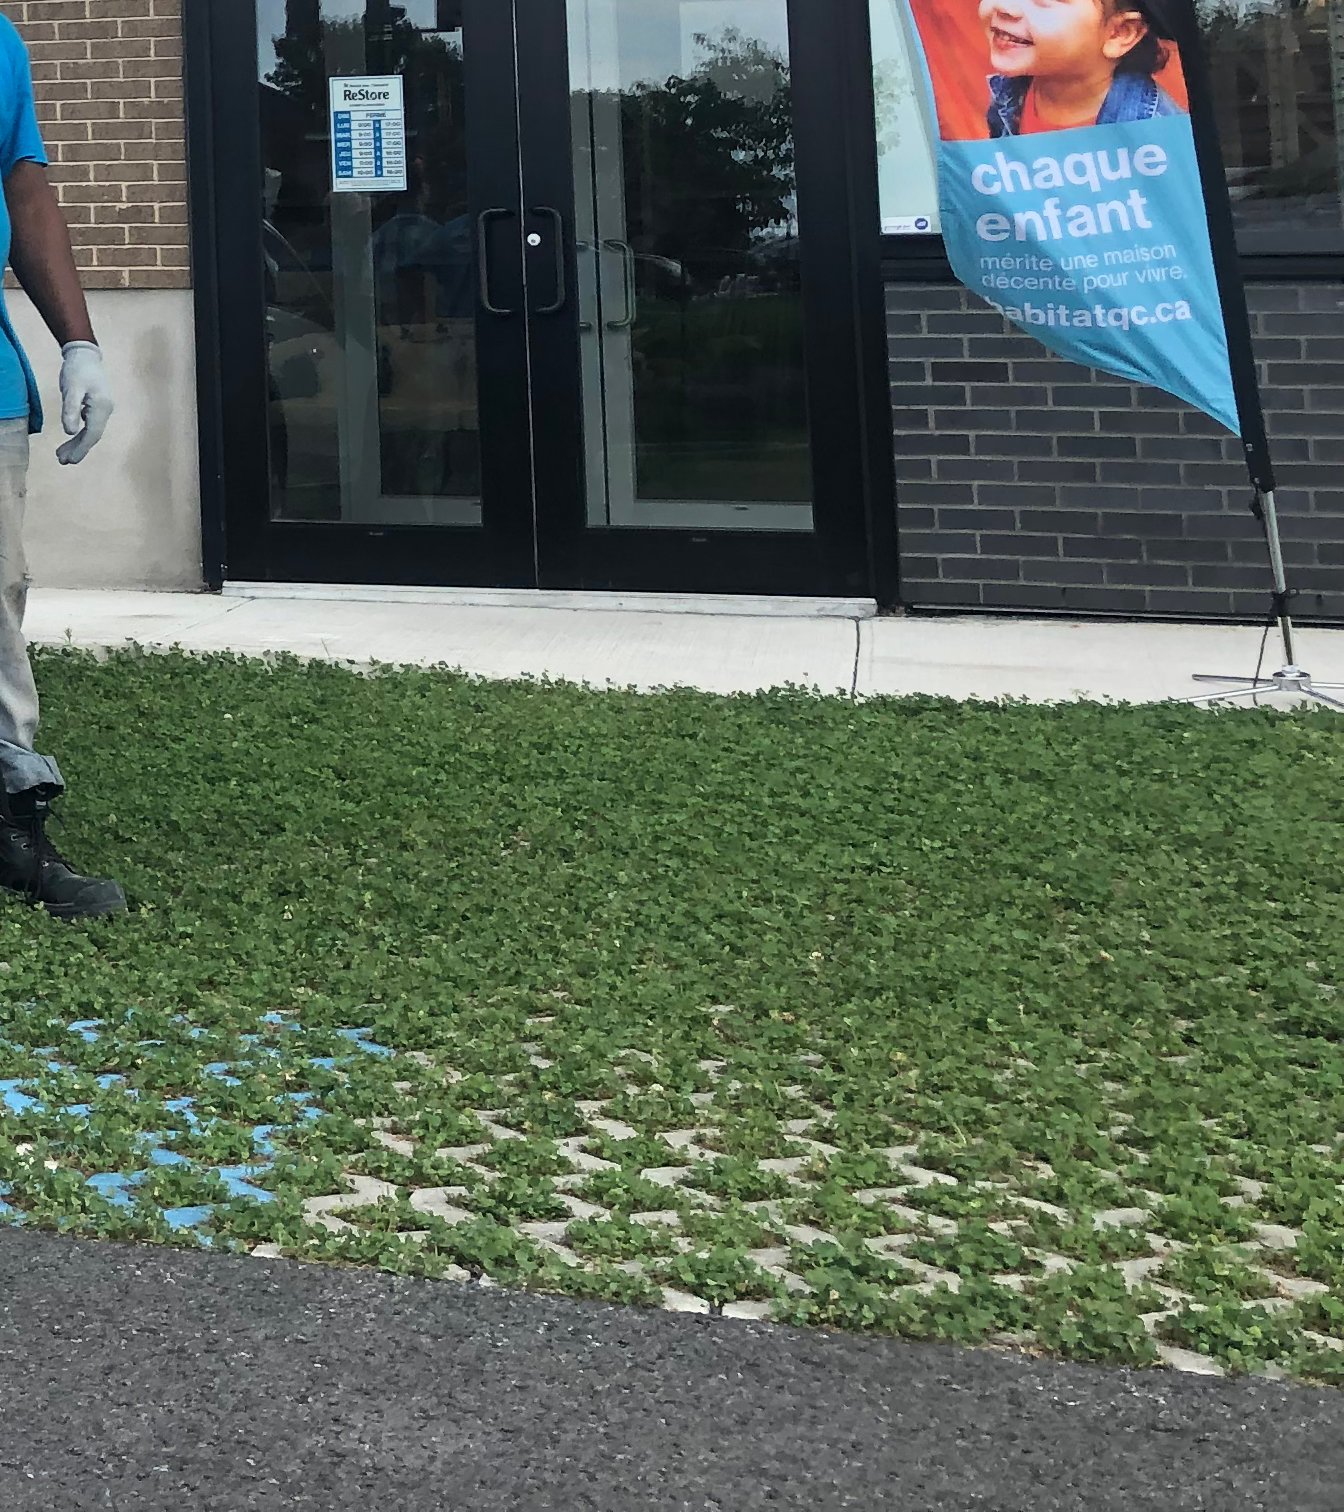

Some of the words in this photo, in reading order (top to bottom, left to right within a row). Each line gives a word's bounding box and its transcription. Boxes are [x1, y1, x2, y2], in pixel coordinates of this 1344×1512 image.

[343, 88, 390, 101] ReStore
[970, 143, 1168, 195] chaque
[976, 188, 1153, 241] enfant
[979, 253, 1055, 272] mérite
[1059, 252, 1100, 269] une
[1103, 243, 1177, 267] maison
[981, 273, 1077, 292] décente
[1082, 271, 1130, 294] pour
[1135, 263, 1189, 283] vivre.
